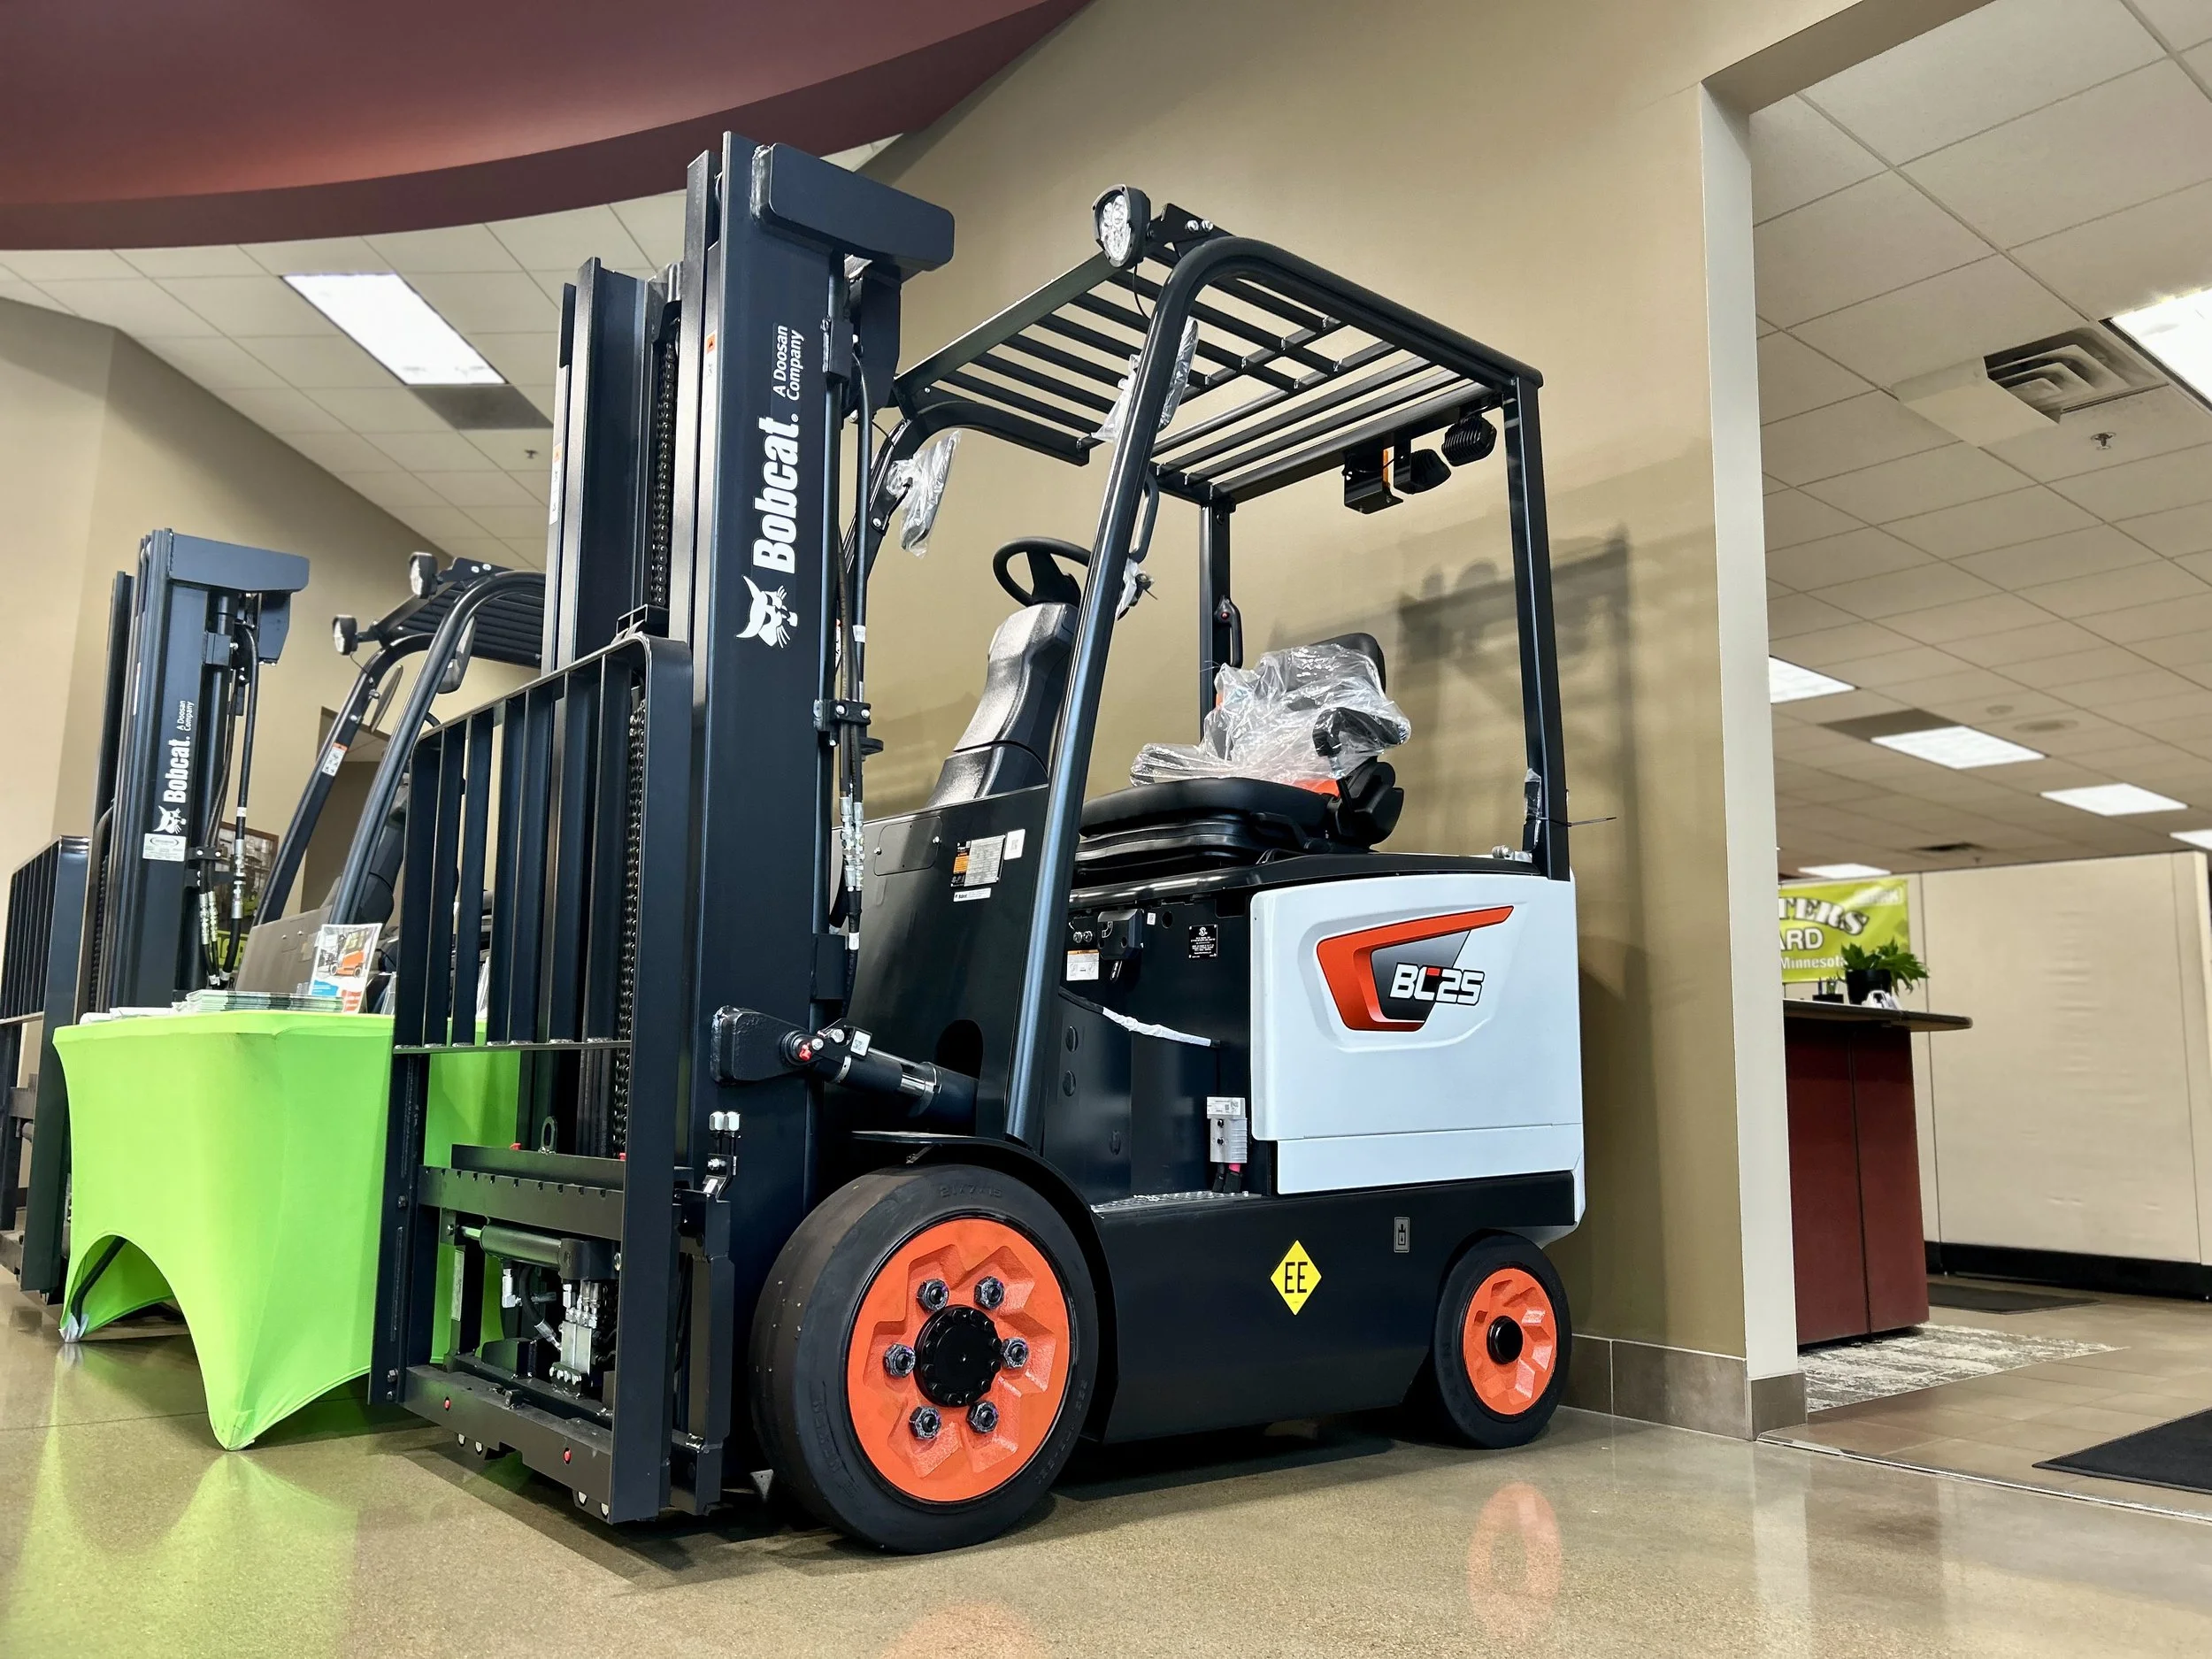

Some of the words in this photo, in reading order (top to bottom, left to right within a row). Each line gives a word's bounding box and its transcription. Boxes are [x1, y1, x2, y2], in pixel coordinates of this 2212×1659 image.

[772, 325, 788, 382] Doosan
[786, 329, 805, 401] Company
[772, 385, 787, 398] A
[752, 416, 800, 574] Bobcat
[177, 700, 187, 725] Doosan
[183, 701, 195, 732] Company
[163, 738, 191, 803] Bobcat
[1389, 962, 1485, 1005] BC25
[1284, 1261, 1309, 1294] EE
